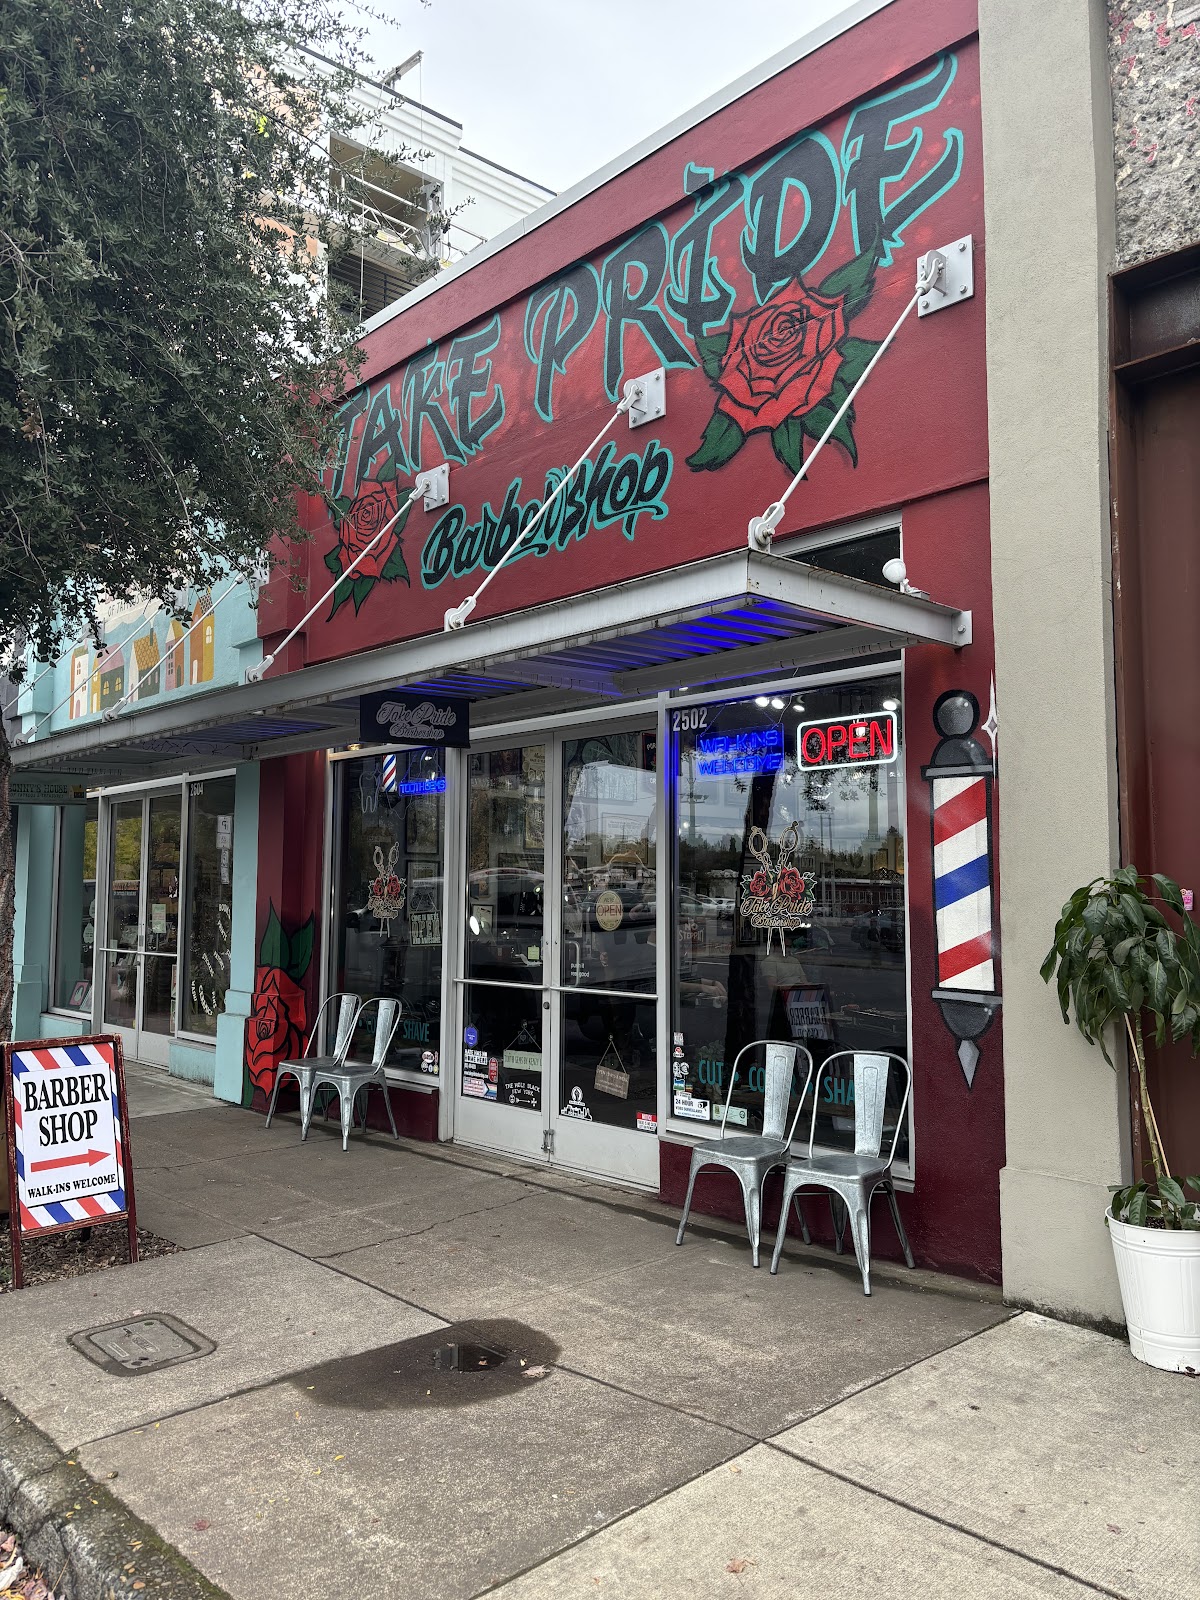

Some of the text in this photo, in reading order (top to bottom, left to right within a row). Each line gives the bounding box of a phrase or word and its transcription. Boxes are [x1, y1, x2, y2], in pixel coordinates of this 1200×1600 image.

[319, 52, 964, 499] TAKE PRIDE
[376, 701, 457, 726] Take Pride
[672, 706, 708, 731] 2502
[802, 719, 893, 763] OPEN
[698, 753, 782, 775] WELCOME
[43, 784, 68, 794] HOUSE
[597, 904, 622, 917] OPEN
[741, 893, 812, 916] Take Pride
[752, 914, 800, 930] Barbershop
[403, 1020, 430, 1042] SHAVE
[698, 1059, 724, 1087] CUT
[748, 1066, 797, 1099] COR
[23, 1073, 109, 1112] BARBER
[39, 1109, 98, 1147] SHOP
[27, 1173, 117, 1199] WALK-INS WELCOME
